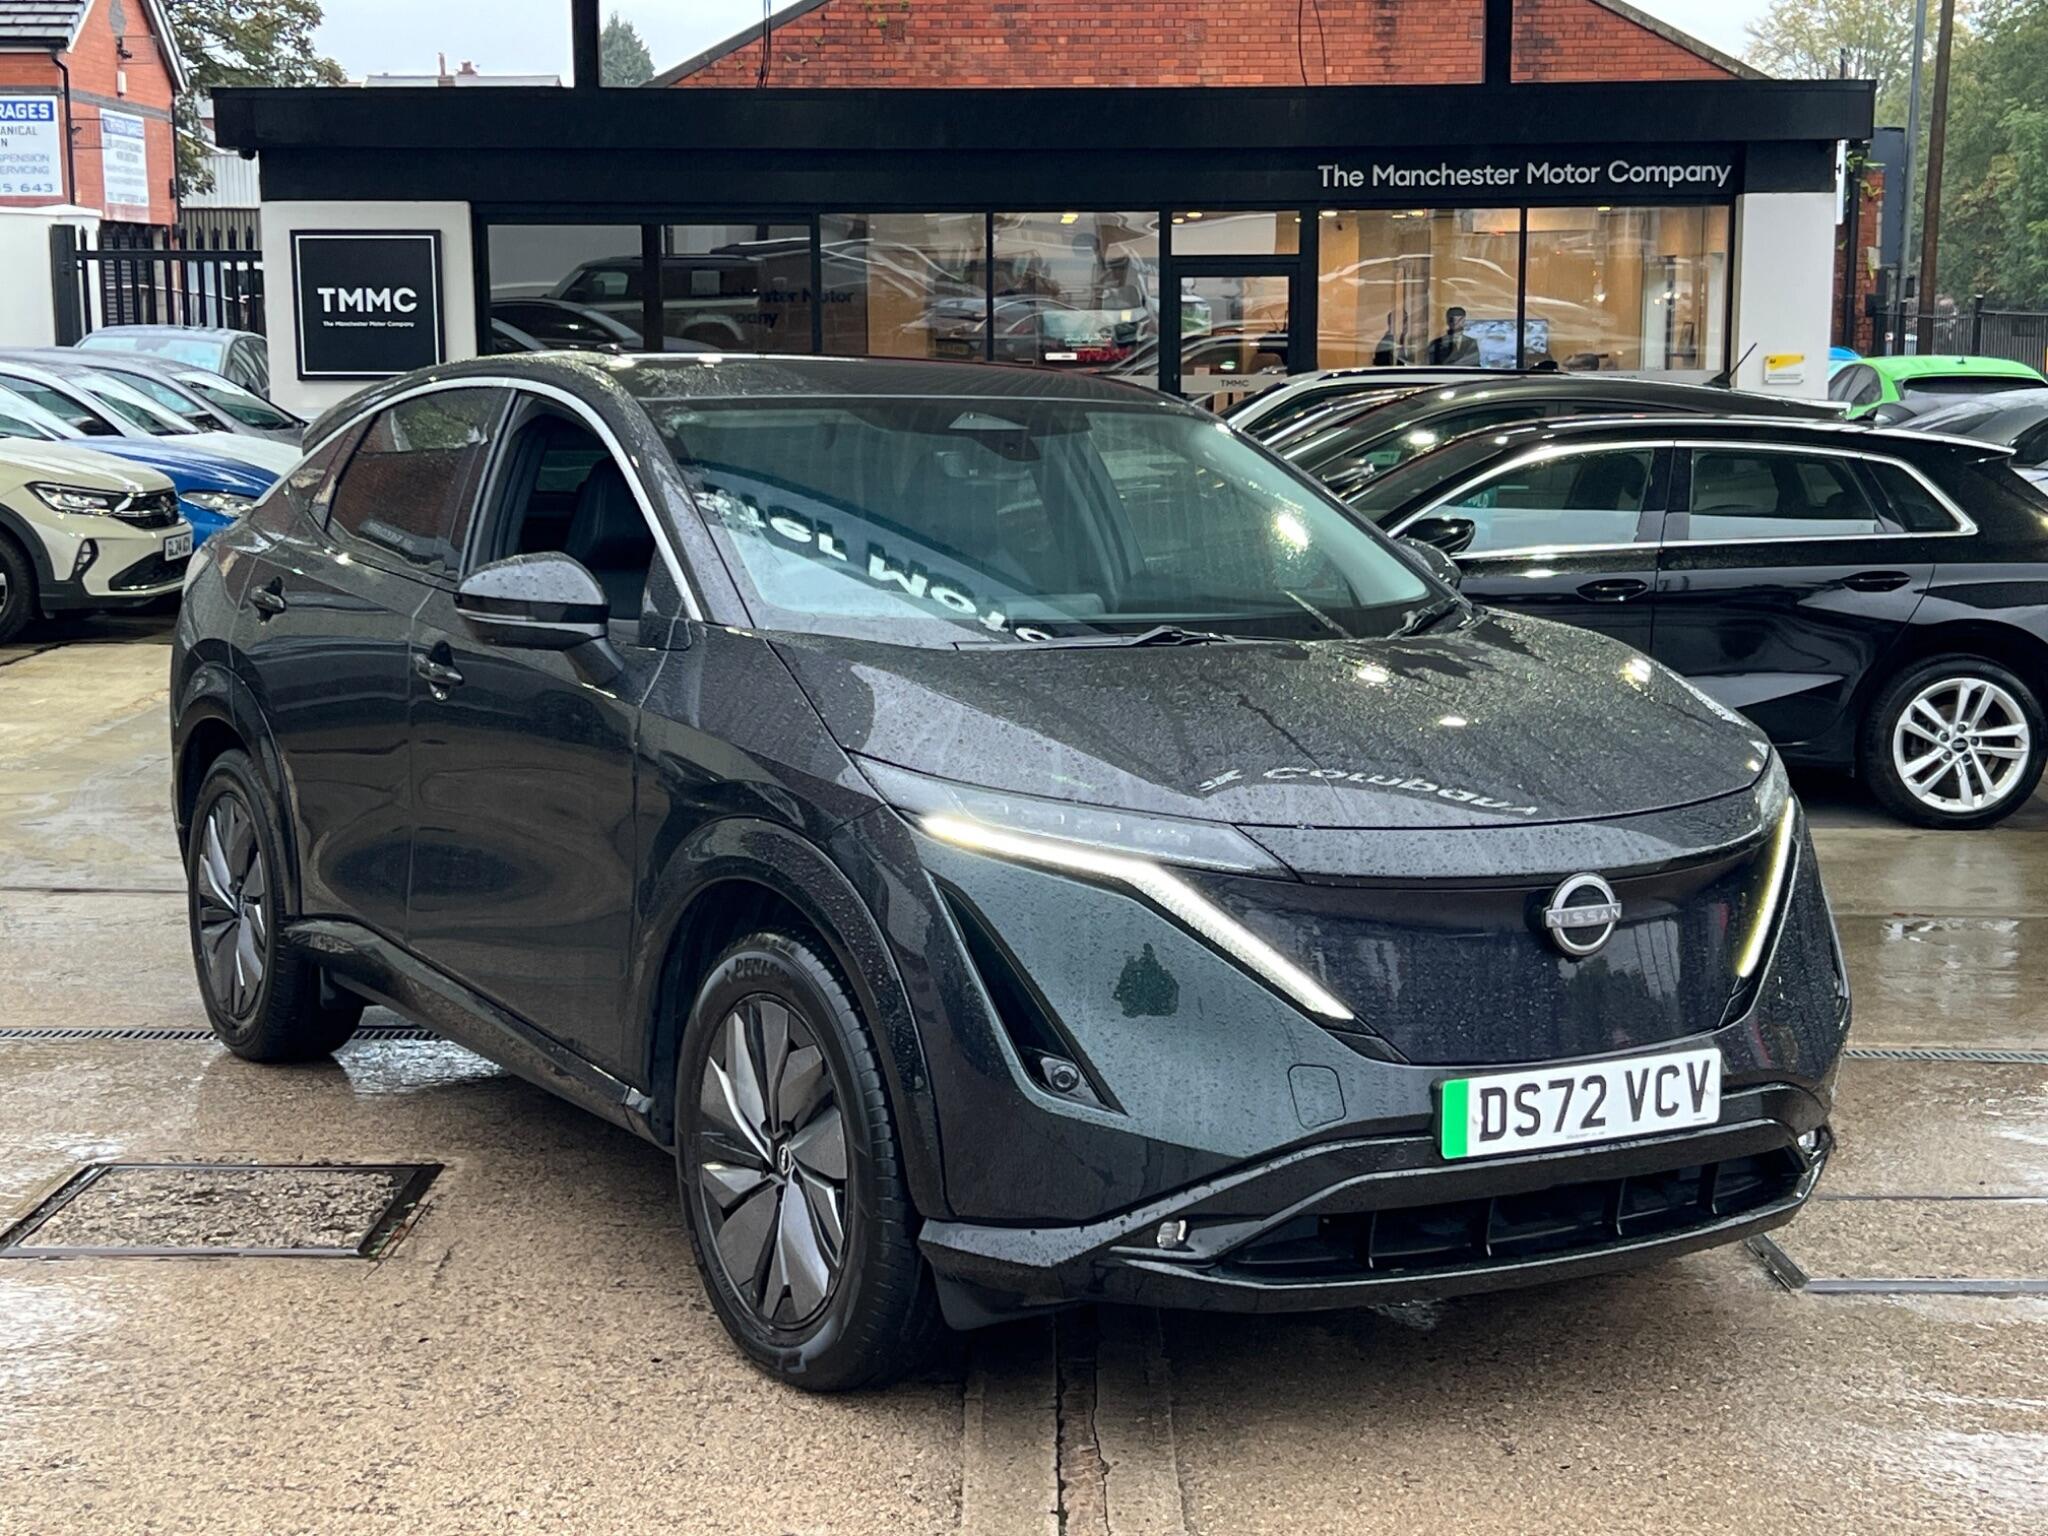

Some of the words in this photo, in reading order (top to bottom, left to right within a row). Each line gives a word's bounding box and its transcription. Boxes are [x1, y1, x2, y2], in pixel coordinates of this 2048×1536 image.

[1318, 164, 1364, 188] The
[1372, 163, 1519, 187] Manchester
[1526, 162, 1600, 186] Motor
[1608, 160, 1732, 188] Company
[20, 183, 53, 192] 643
[317, 287, 418, 313] TMMC
[387, 320, 415, 328] Company
[1221, 379, 1250, 388] TMMC
[1547, 907, 1621, 927] NISSAN
[1478, 1074, 1608, 1143] DS72
[1624, 1059, 1711, 1123] VCV
